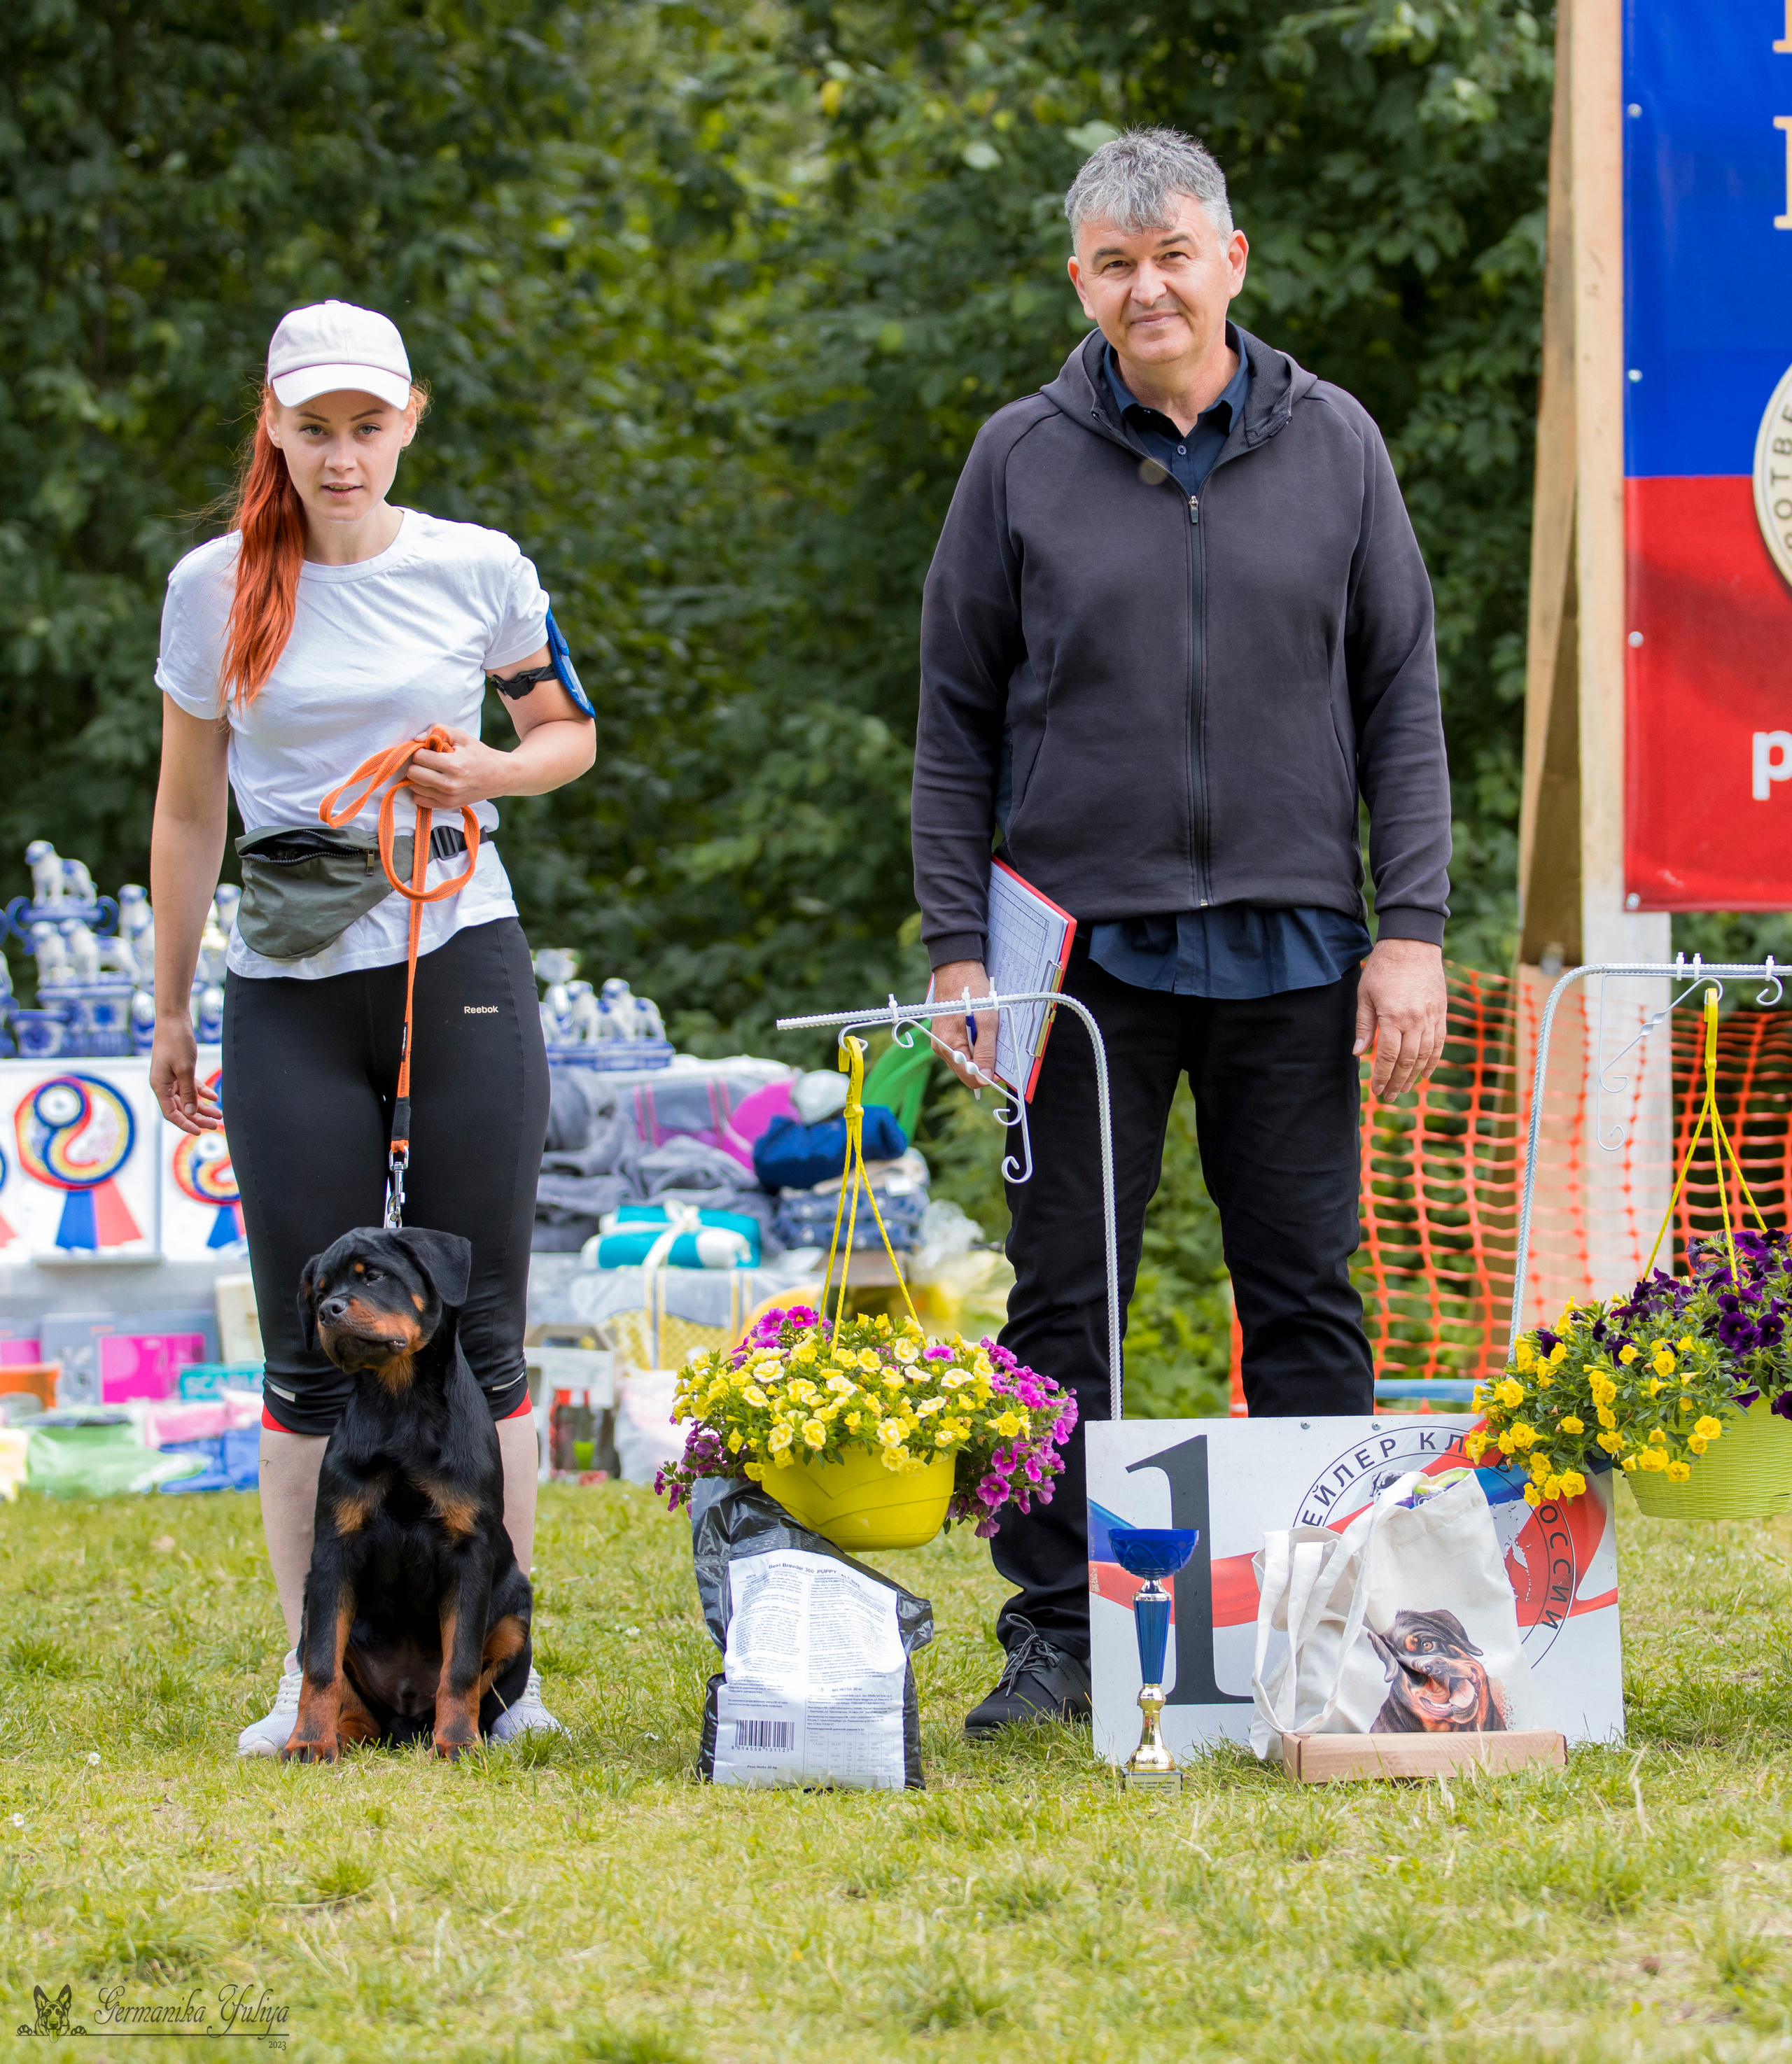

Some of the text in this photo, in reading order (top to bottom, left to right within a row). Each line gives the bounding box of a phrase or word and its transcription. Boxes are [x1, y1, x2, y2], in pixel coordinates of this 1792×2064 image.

[464, 1005, 499, 1014] Reebok
[782, 1562, 804, 1571] Breeder
[1125, 1435, 1256, 1706] 1
[1301, 1432, 1572, 1630] ЕЙЛЕР КЛБ ОССИИ
